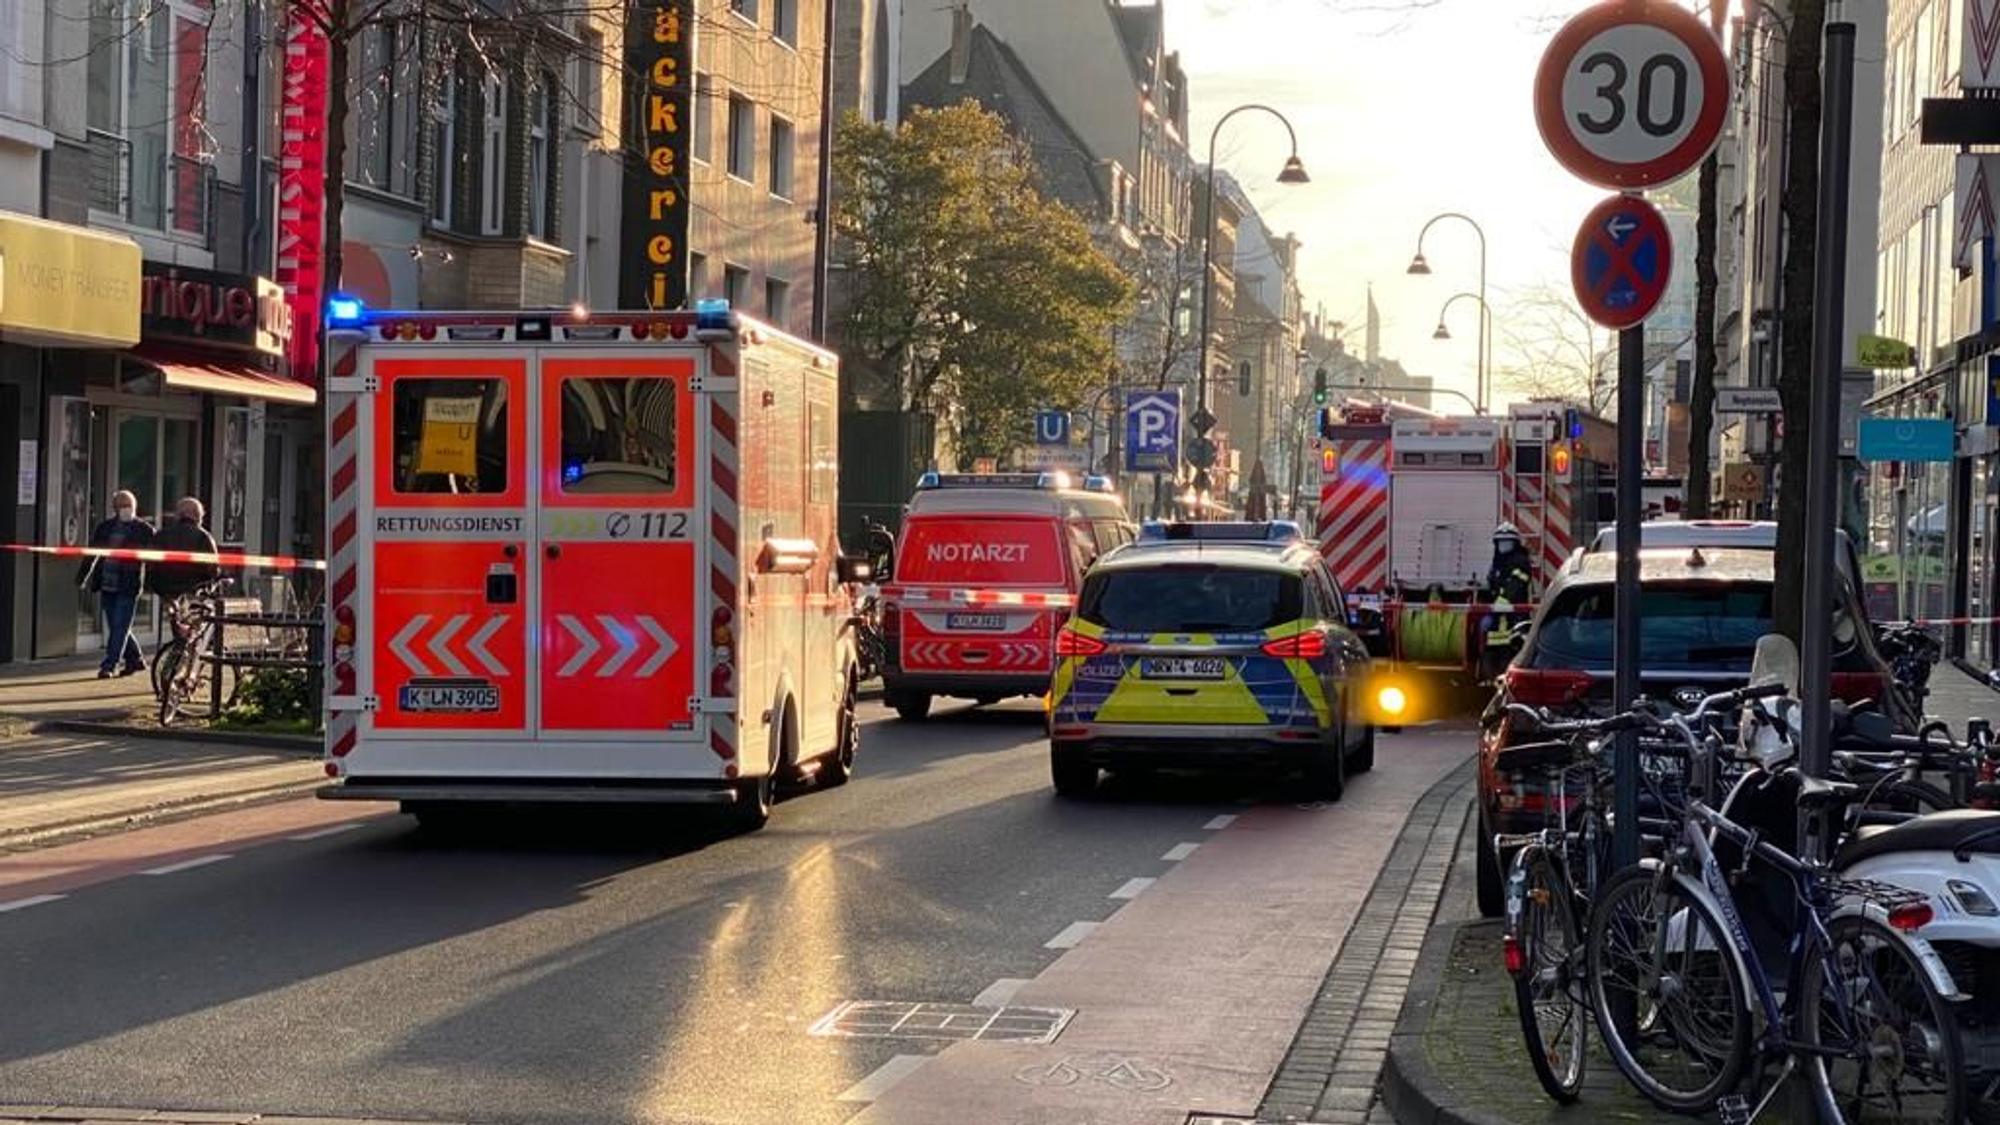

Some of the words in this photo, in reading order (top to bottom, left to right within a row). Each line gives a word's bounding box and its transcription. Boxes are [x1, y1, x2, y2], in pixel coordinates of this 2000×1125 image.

[1577, 52, 1688, 137] 30
[17, 262, 65, 291] MONEY
[71, 270, 130, 302] TRANSFER
[1043, 416, 1064, 441] U
[1139, 409, 1165, 447] P
[375, 516, 523, 532] RETTUNGSDIENST
[639, 512, 688, 538] 112
[927, 543, 1029, 562] NOTARZT
